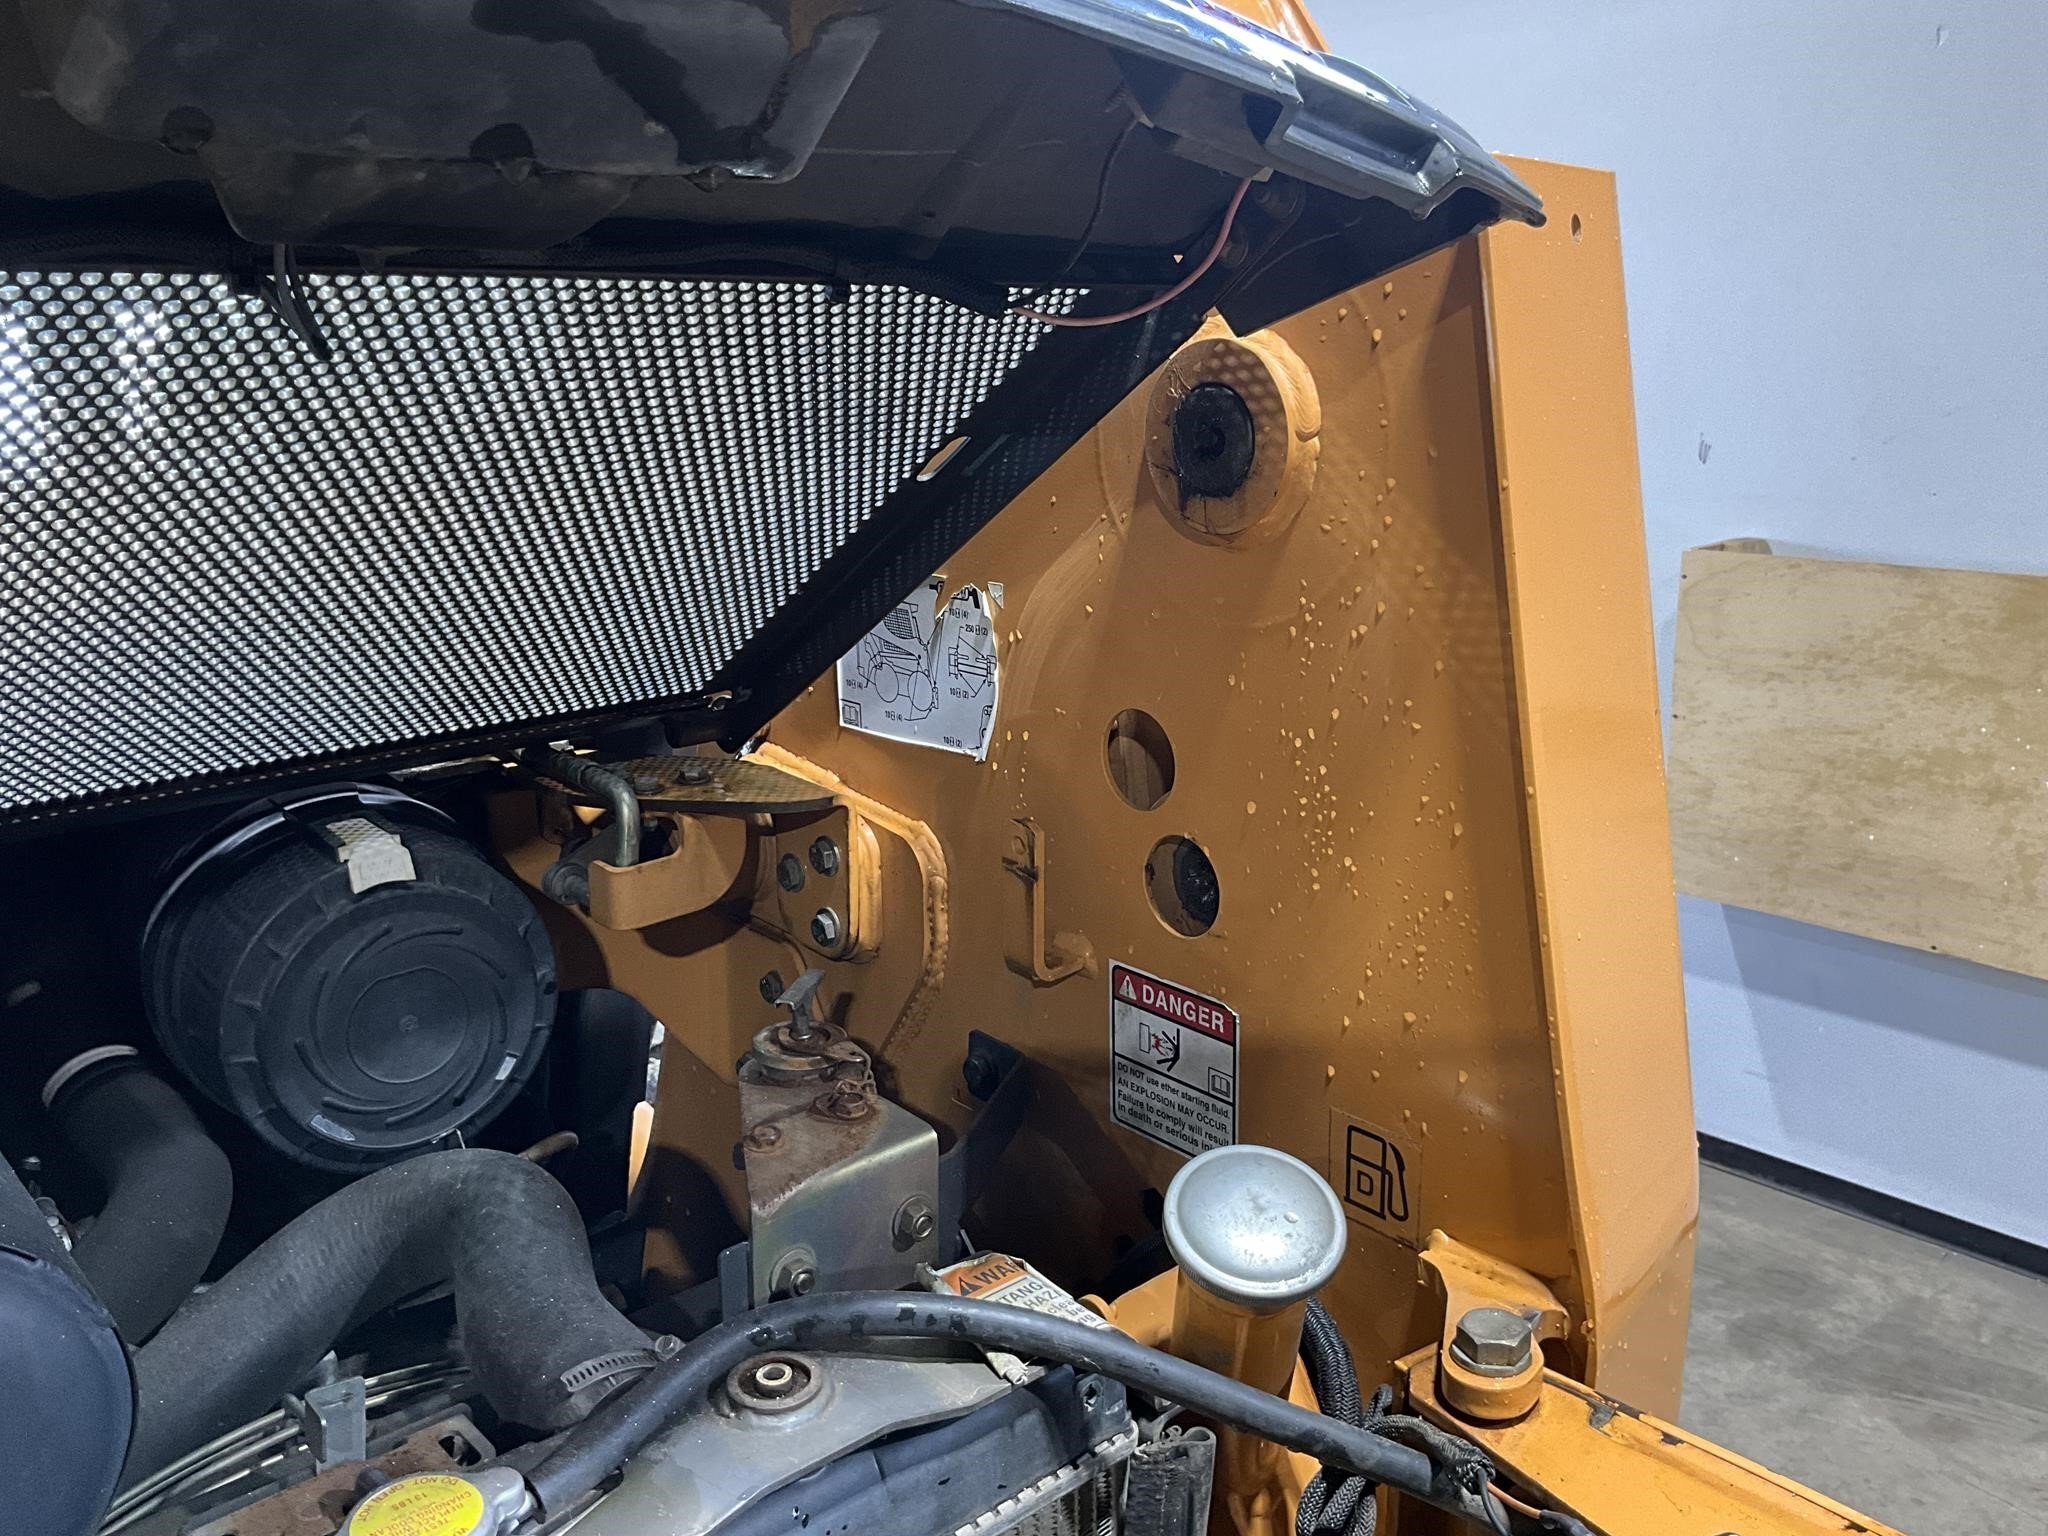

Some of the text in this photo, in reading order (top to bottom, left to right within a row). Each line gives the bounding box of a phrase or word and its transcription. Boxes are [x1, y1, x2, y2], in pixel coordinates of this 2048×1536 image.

[1142, 984, 1224, 1033] DANGER
[1118, 1062, 1230, 1119] DO NOT use ether starting fluid.
[1118, 1077, 1229, 1134] AN EXPLOSION MAY OCCUR.
[1118, 1090, 1229, 1146] Failure to comply will result
[1118, 1102, 1126, 1112] in
[1128, 1107, 1152, 1125] death
[1154, 1119, 1163, 1130] or
[1165, 1125, 1199, 1147] serious
[996, 1281, 1043, 1304] TANG
[372, 1484, 404, 1504] OPEN
[414, 1477, 438, 1485] NOT
[441, 1477, 457, 1485] DO
[416, 1491, 472, 1519] CHANGING
